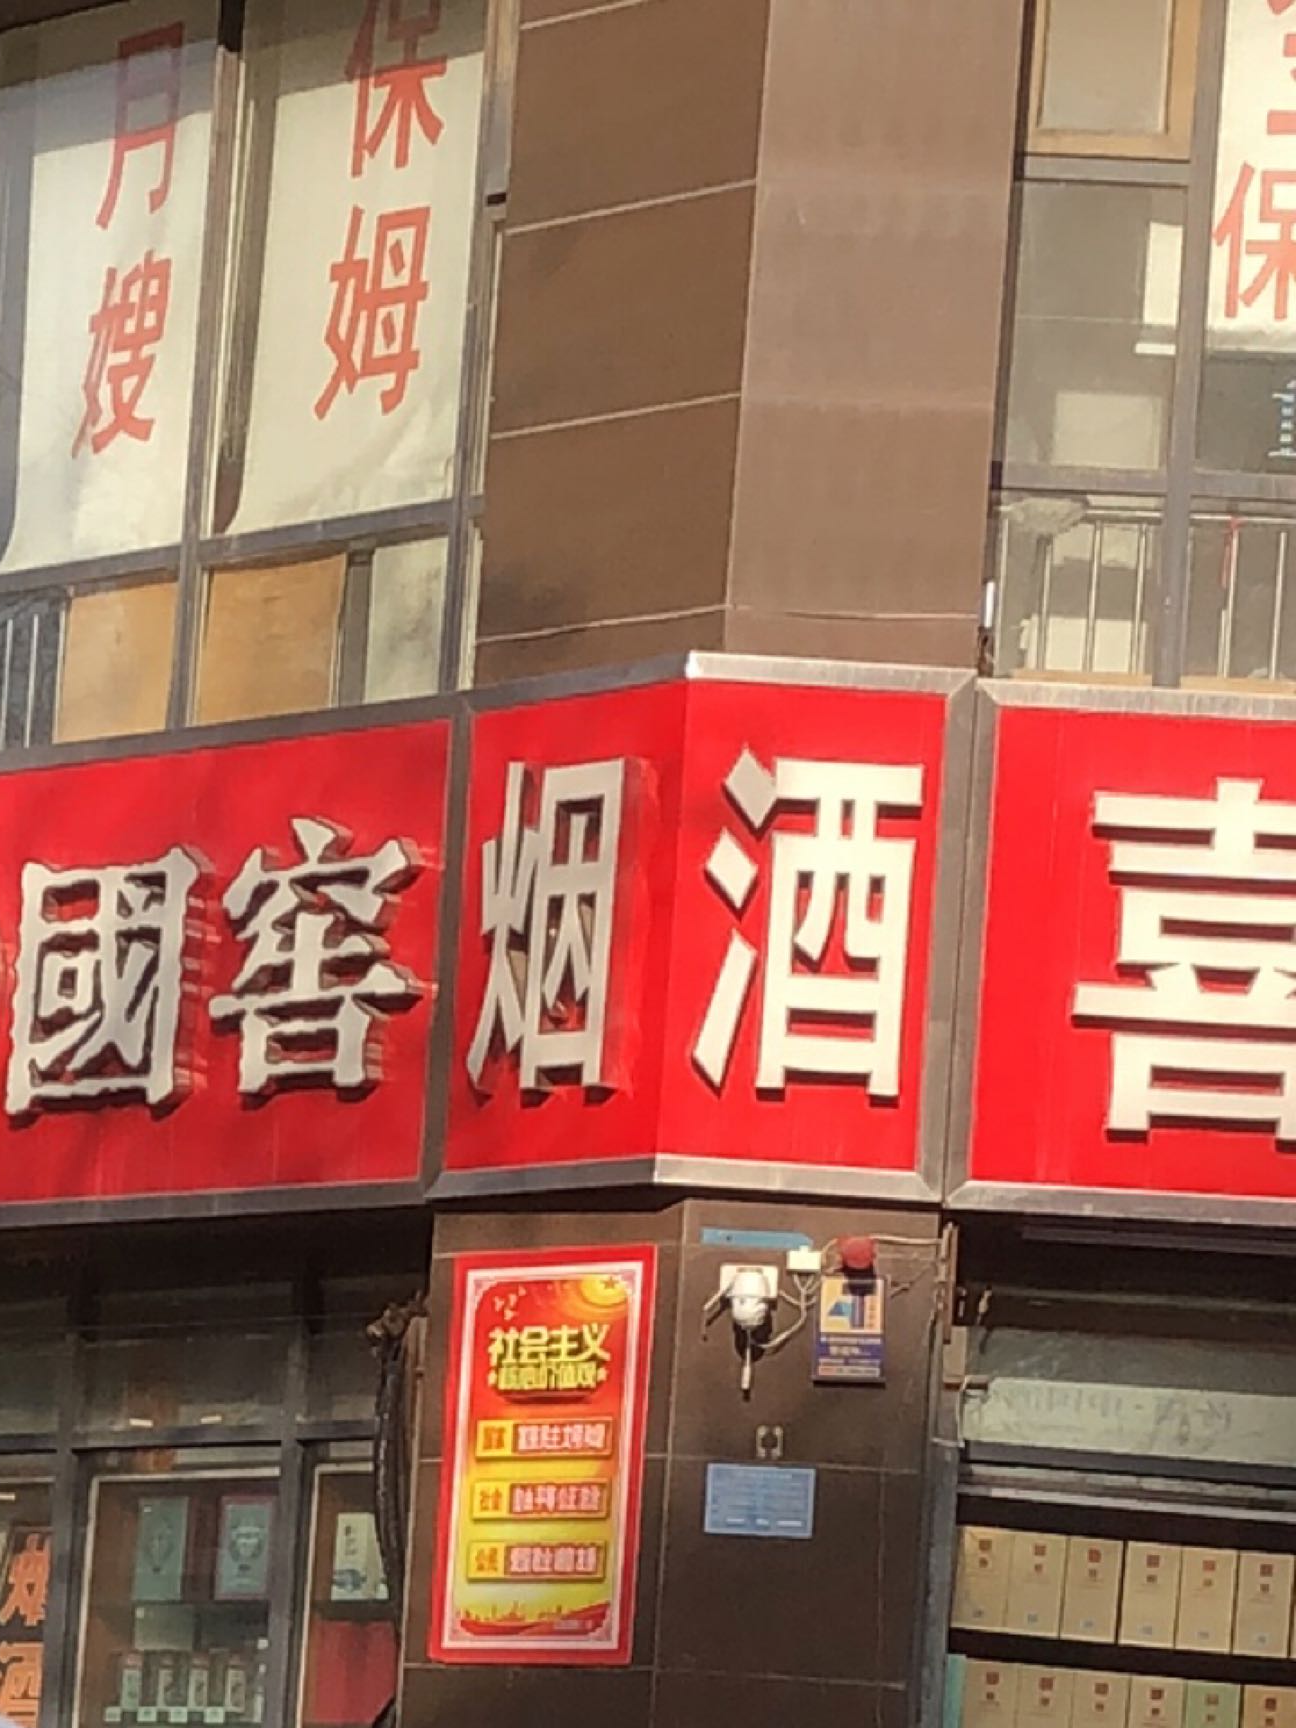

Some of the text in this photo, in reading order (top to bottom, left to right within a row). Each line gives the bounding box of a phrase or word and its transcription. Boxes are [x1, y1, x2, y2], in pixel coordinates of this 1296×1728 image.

[71, 22, 186, 457] 月嫂
[314, 0, 446, 420] 保姆
[4, 817, 438, 1126] 國窖
[1071, 776, 1296, 1142] 喜
[487, 1322, 611, 1367] 社会主义
